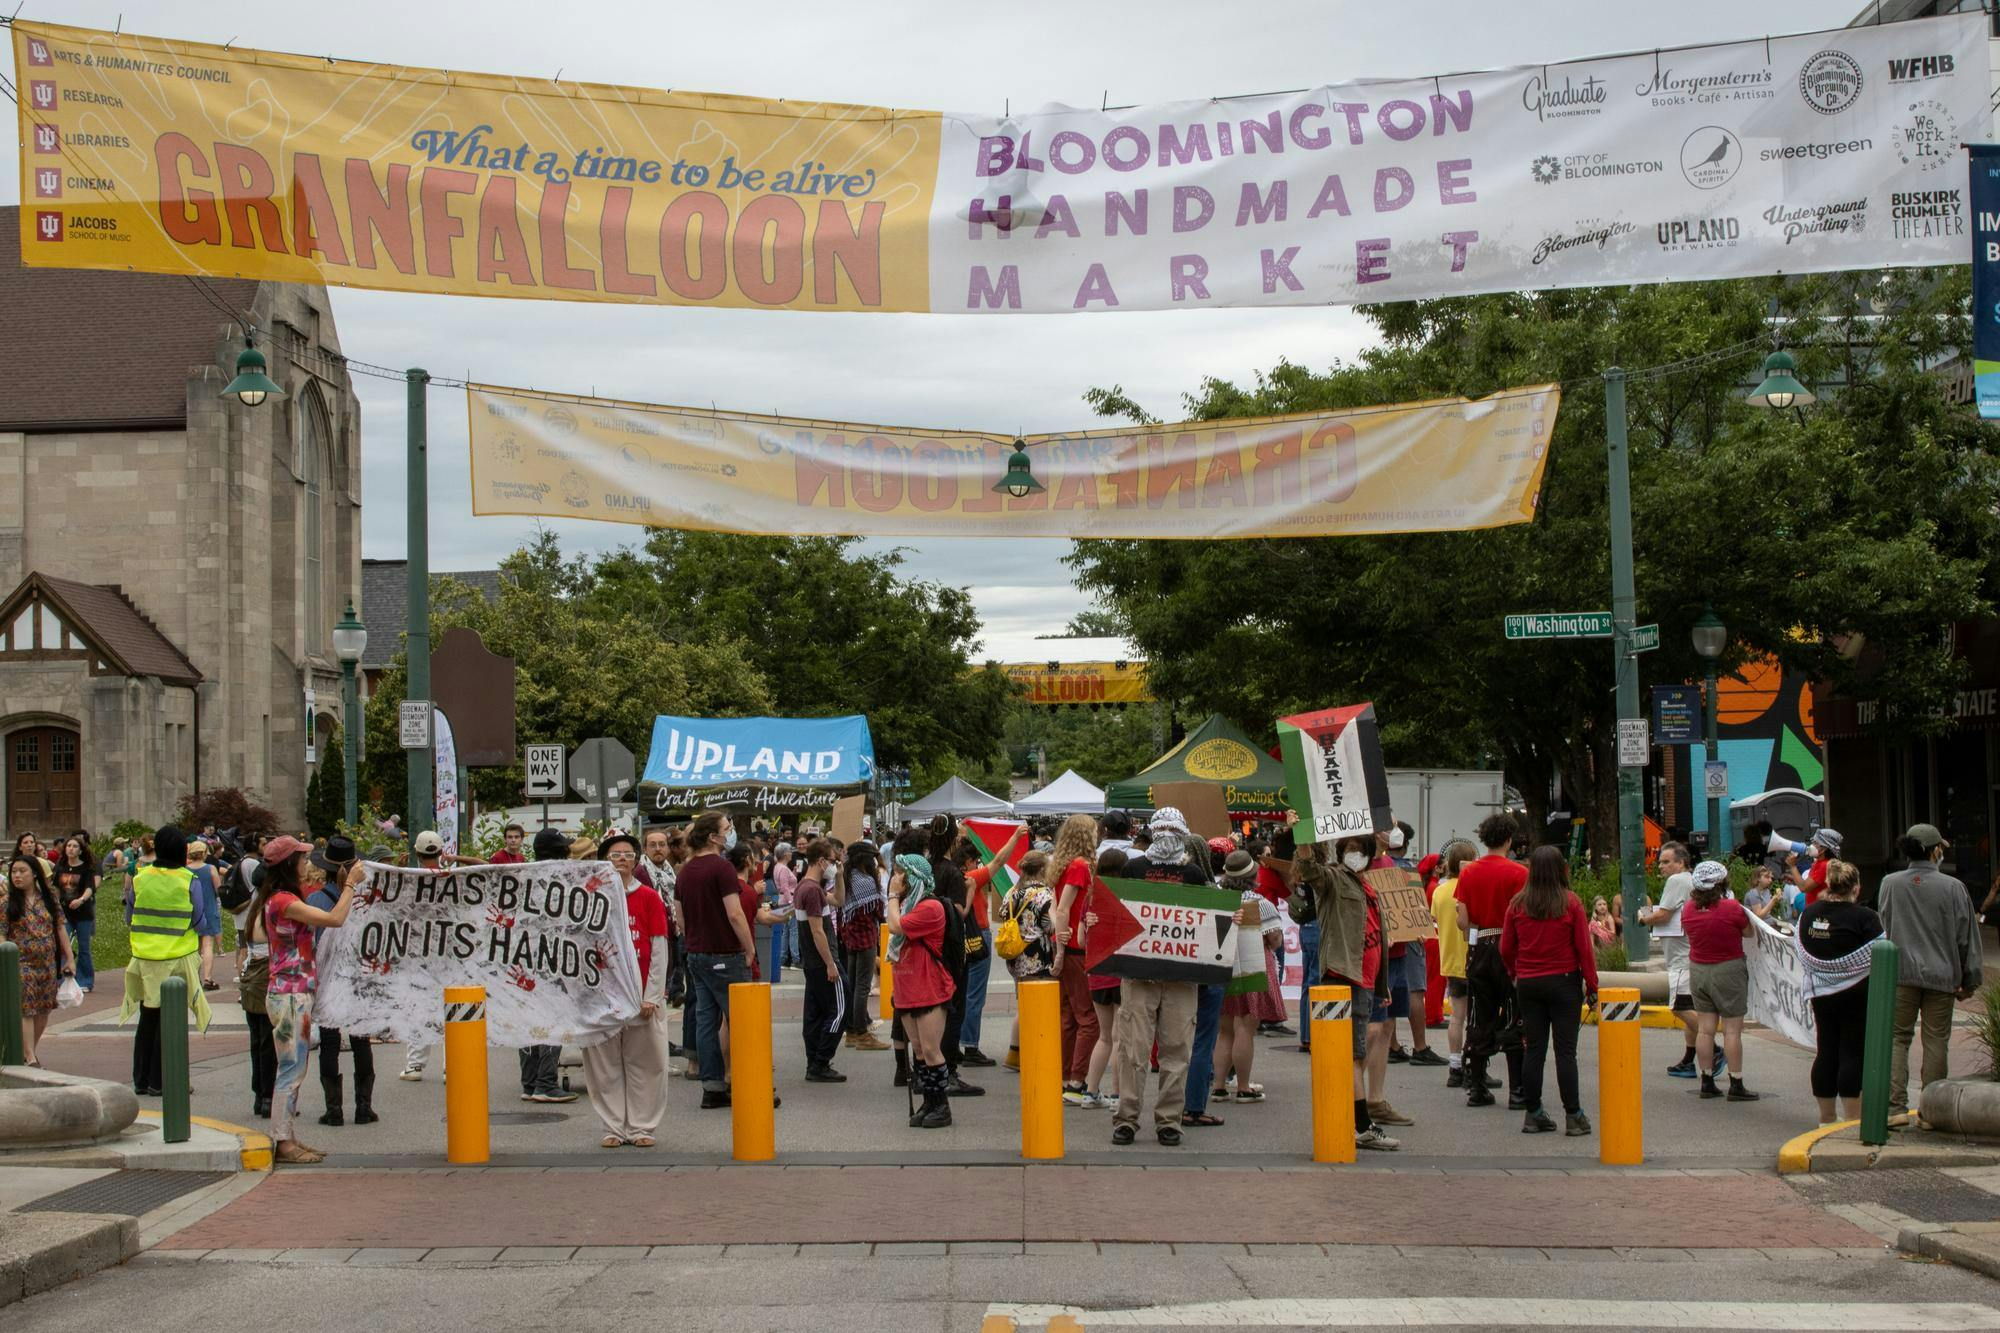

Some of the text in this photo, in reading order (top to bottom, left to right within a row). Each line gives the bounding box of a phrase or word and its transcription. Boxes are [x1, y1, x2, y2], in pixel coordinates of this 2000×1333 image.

[54, 50, 232, 83] ARTS & HUMANITIES COUNCIL
[1888, 55, 1955, 80] WFHB
[1636, 68, 1772, 97] Morgenstern's
[1807, 69, 1856, 89] Bloomington
[63, 89, 124, 108] RESEARCH
[1523, 75, 1606, 123] Graduate
[1651, 94, 1687, 107] Books
[1733, 88, 1775, 102] Artisan
[1815, 83, 1849, 97] Brewing
[1547, 108, 1601, 119] BLOOMINGTON
[1914, 115, 1934, 129] We
[65, 133, 130, 148] LIBRARIES
[976, 90, 1474, 177] BLOOMINGTON
[1904, 127, 1944, 143] Work
[1760, 138, 1873, 162] sweetgreen
[1915, 143, 1939, 156] It.
[411, 125, 875, 198] What a time to be alive
[1564, 153, 1608, 167] CITY OF
[1565, 160, 1663, 180] BLOOMINGTON
[1693, 168, 1729, 177] CARDINAL
[1698, 176, 1724, 184] SPIRITS
[67, 176, 115, 191] CINEMA
[968, 159, 1478, 240] HANDMADE
[1891, 189, 1961, 207] BUSKIRK
[154, 132, 886, 307] GRANFALLOON
[1763, 197, 1868, 226] Underground
[1891, 203, 1961, 220] CHUMLEY
[68, 216, 117, 230] JACOBS
[1658, 217, 1740, 245] UPLAND
[1784, 217, 1850, 245] Printing
[1891, 217, 1963, 240] THEATER
[69, 231, 131, 242] SCHOOL OF MUSIC
[1532, 221, 1636, 265] Bloomington
[1663, 242, 1723, 252] BREWING
[967, 230, 1478, 309] MARKET
[1508, 615, 1610, 635] 100 Washington St
[1513, 627, 1518, 636] S
[531, 750, 558, 762] ONE
[667, 728, 841, 774] UPLAND
[530, 763, 560, 776] WAY
[670, 770, 829, 780] BREWING CO
[656, 786, 840, 811] Craft your next Adventure
[1226, 784, 1276, 807] Brewing
[1314, 808, 1373, 836] GENOCIDE
[369, 871, 610, 933] IU HAS BLOOD
[1378, 889, 1426, 909] ITTEN
[1140, 905, 1207, 926] DIVEST
[1149, 924, 1196, 940] FROM
[360, 920, 411, 962] ON
[423, 920, 478, 959] ITS
[488, 925, 602, 989] HANDS
[1139, 940, 1200, 959] CRANE
